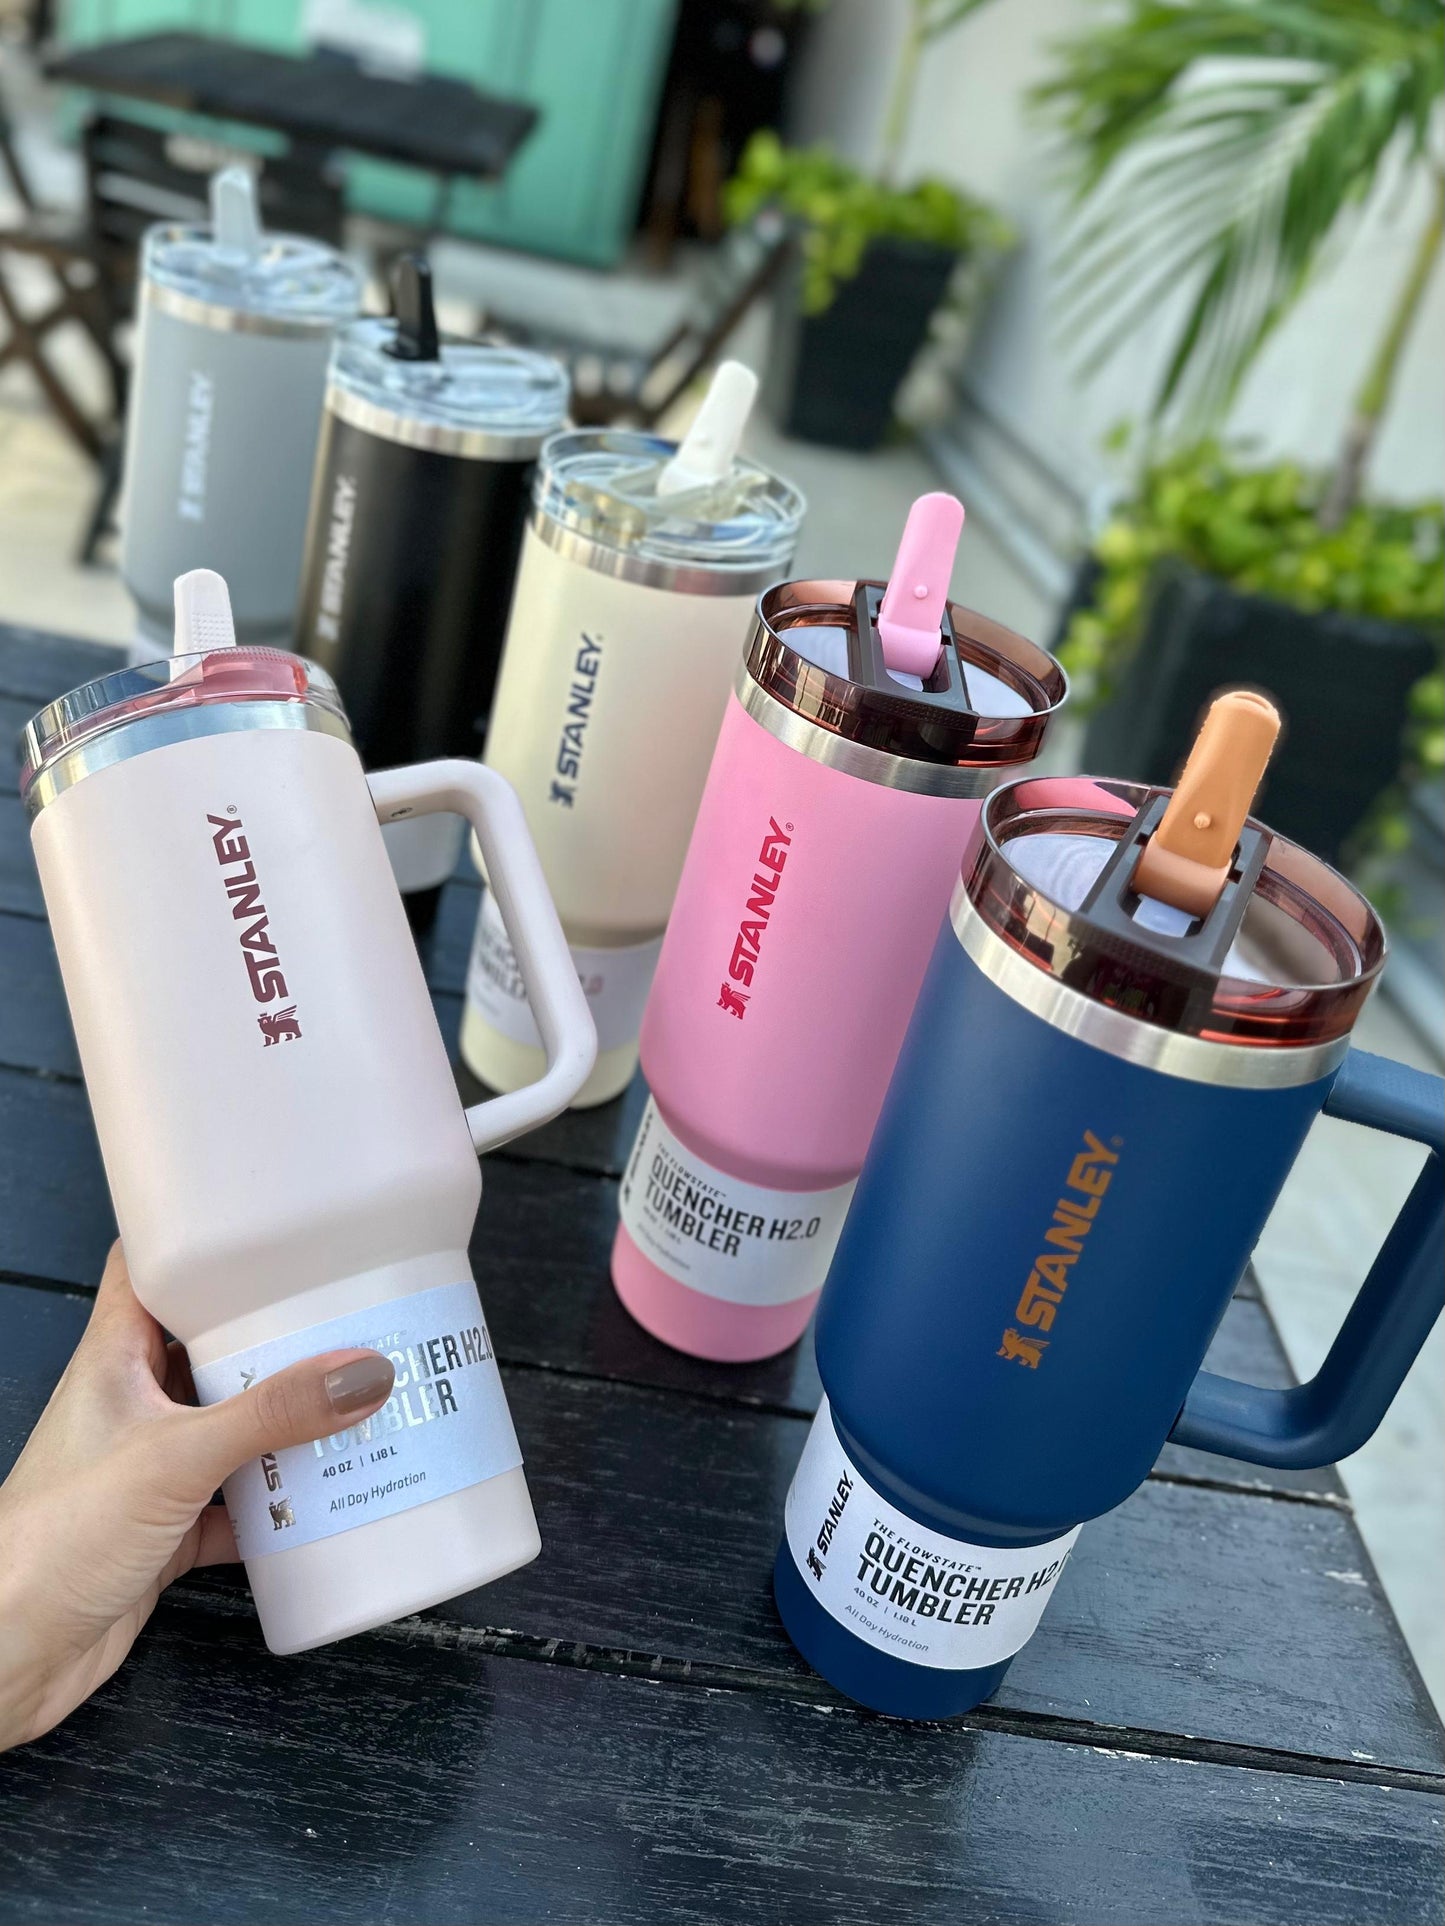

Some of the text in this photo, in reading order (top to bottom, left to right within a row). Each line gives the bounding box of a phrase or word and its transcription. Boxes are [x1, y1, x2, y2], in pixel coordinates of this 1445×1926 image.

[645, 1175, 741, 1257] TUMBLER
[651, 1153, 765, 1238] QUENCHER
[768, 1216, 821, 1241] H2.0
[322, 1445, 398, 1479] 40 OZ 1.18 L
[330, 1471, 427, 1513] All Day Hydration
[872, 1517, 896, 1540] THE
[856, 1552, 996, 1626] TUMBLER
[864, 1531, 1026, 1601] QUENCHER
[844, 1604, 930, 1652] All Day Hydration
[853, 1587, 866, 1598] 40
[866, 1595, 880, 1608] OZ
[911, 1619, 917, 1627] L
